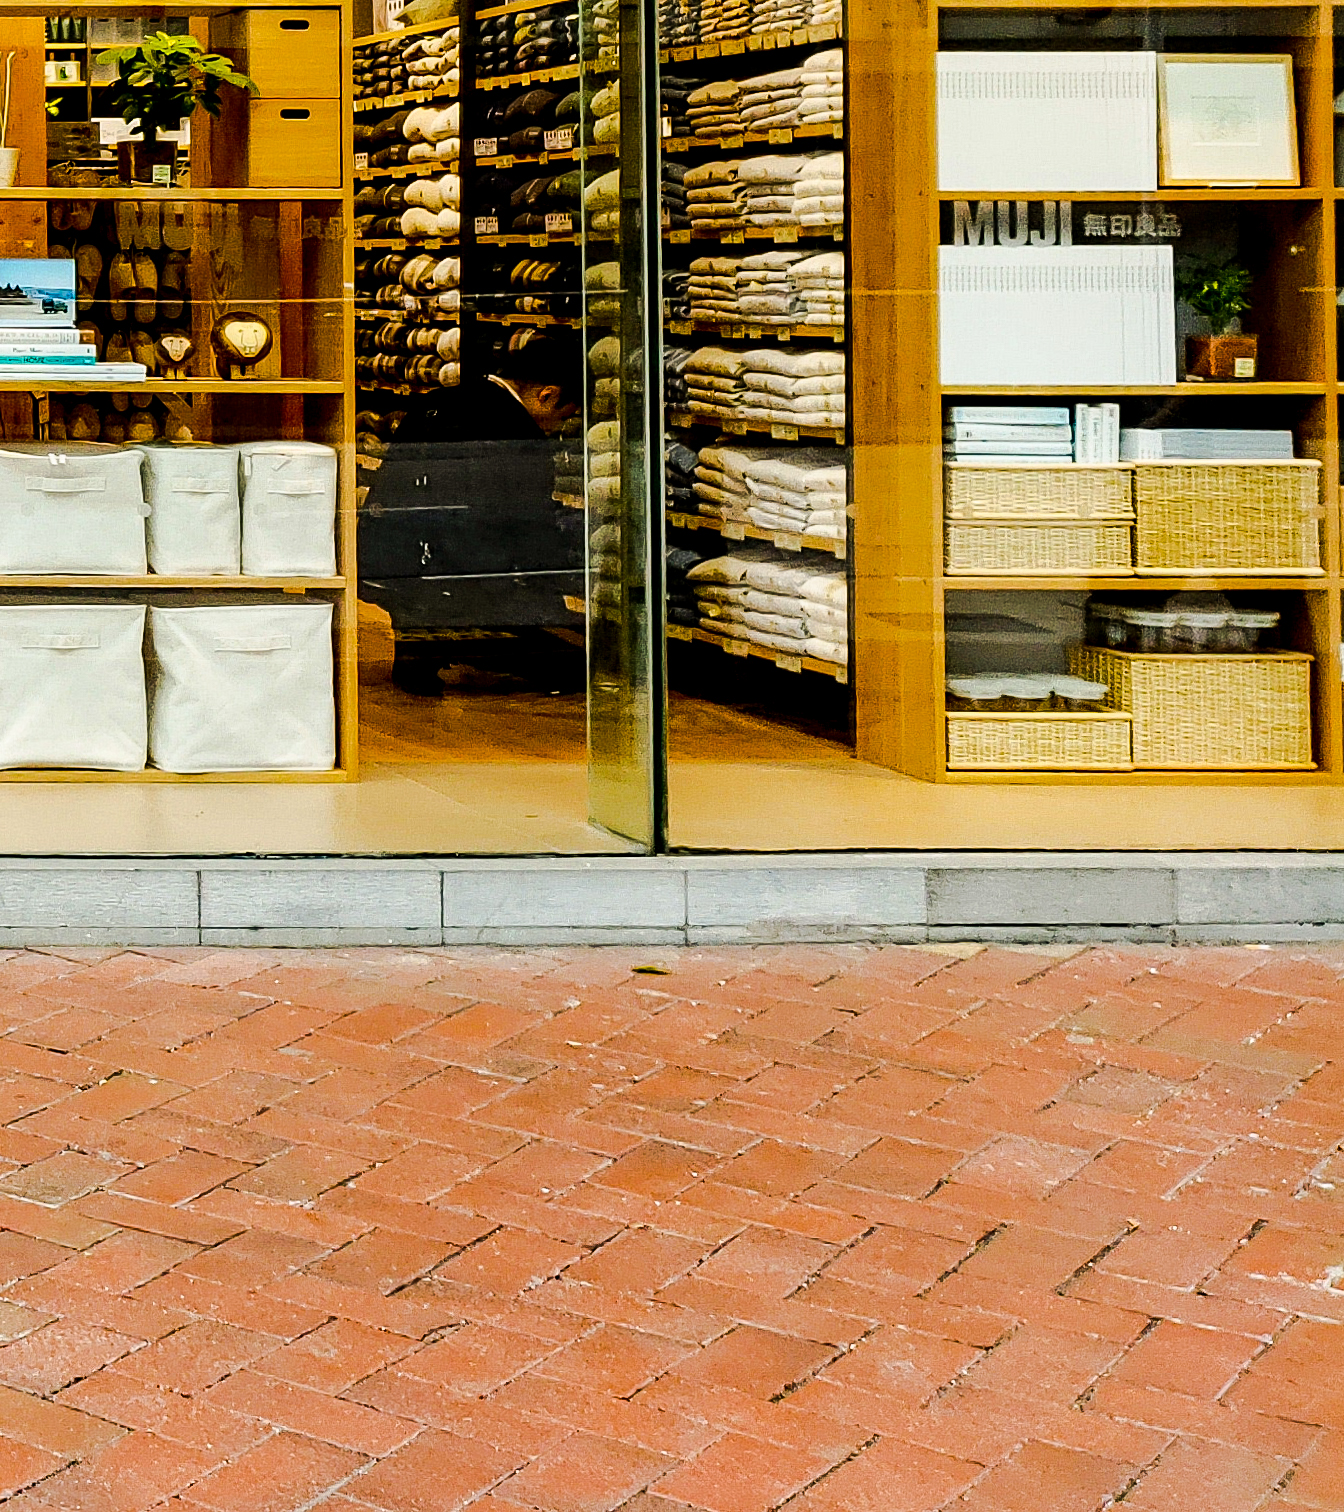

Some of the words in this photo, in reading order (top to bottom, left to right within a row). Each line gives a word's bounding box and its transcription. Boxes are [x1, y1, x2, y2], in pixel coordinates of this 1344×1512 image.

[953, 200, 1073, 247] MUJI
[1083, 212, 1182, 238] 無印良品
